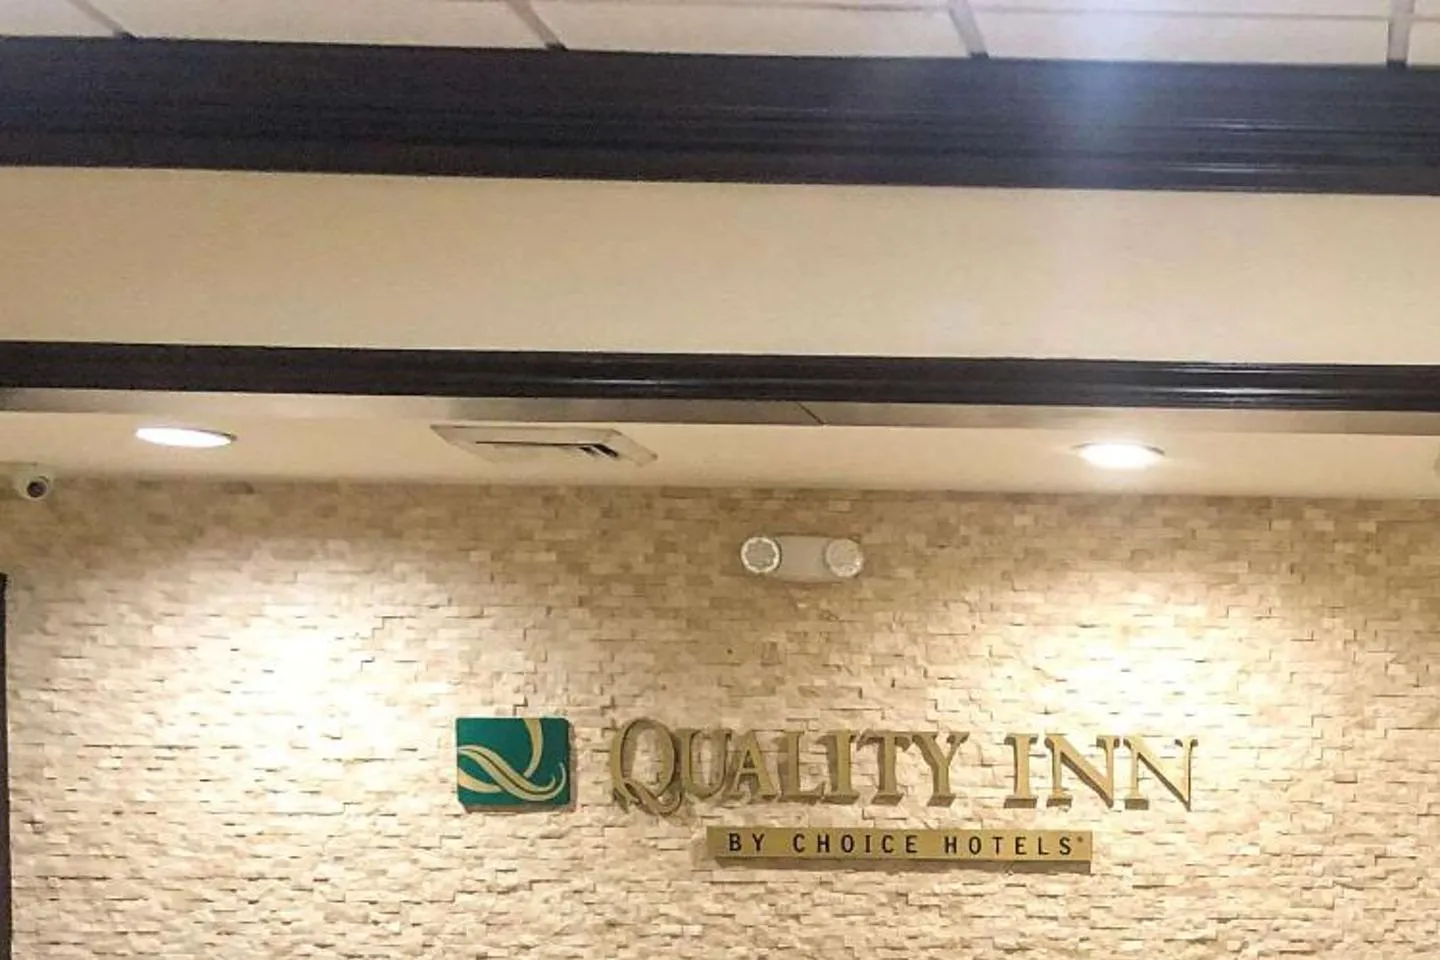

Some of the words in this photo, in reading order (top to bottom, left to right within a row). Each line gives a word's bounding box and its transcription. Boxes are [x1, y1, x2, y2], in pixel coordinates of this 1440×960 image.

[608, 717, 971, 817] QUALITY
[1002, 733, 1201, 812] INN
[728, 832, 766, 853] BY
[792, 832, 918, 855] CHOICE
[943, 833, 1073, 856] HOTELS
